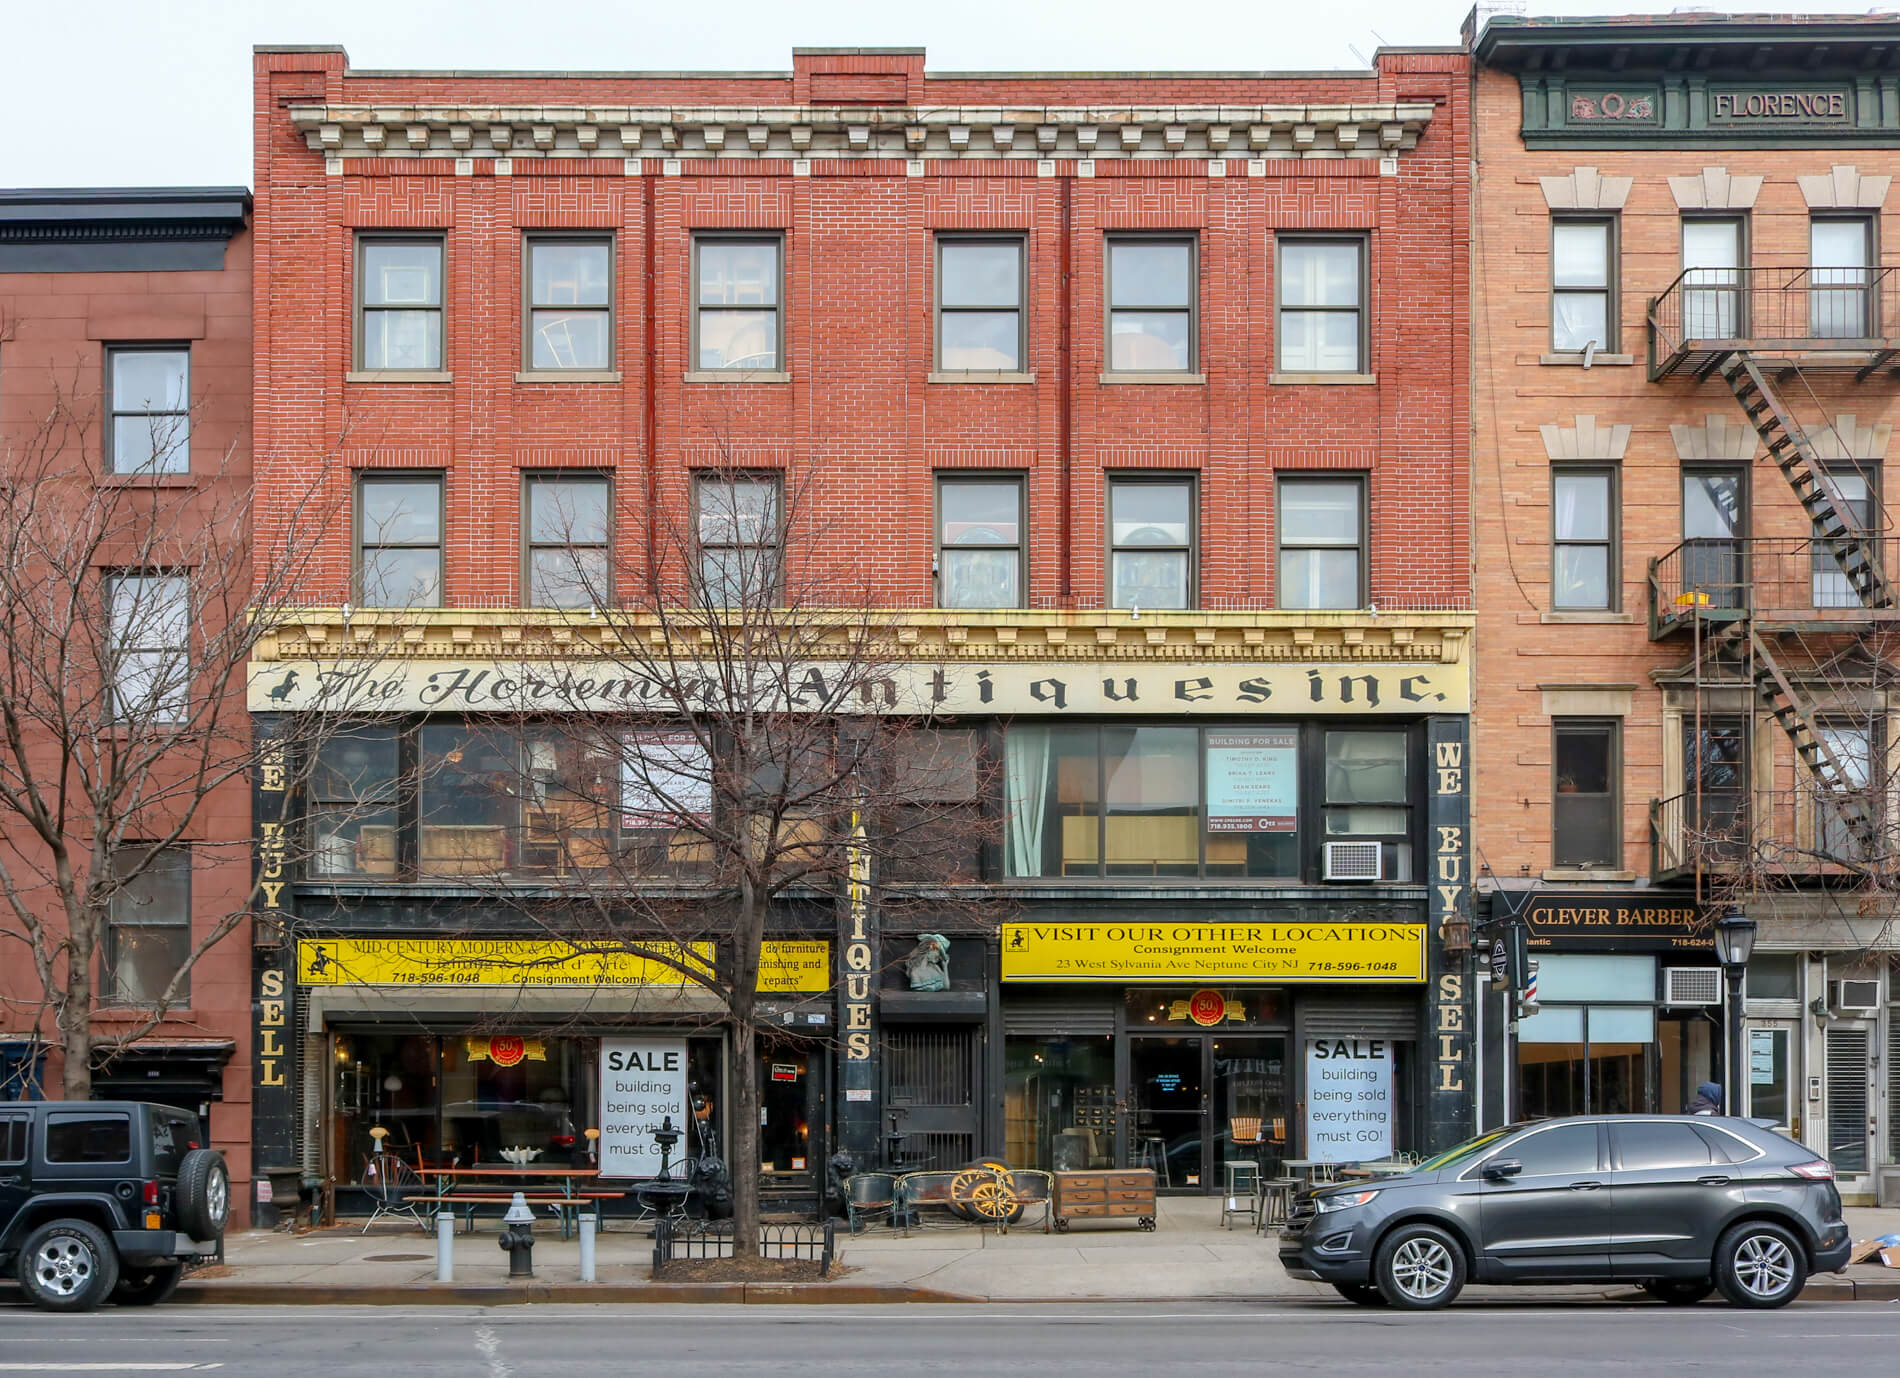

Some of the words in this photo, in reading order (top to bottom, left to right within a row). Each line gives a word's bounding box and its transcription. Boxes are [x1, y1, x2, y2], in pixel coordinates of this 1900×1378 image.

[1714, 93, 1844, 117] FLORENCE
[316, 667, 403, 699] The
[790, 666, 1272, 710] Antiques
[1308, 669, 1447, 709] inc.
[1436, 742, 1462, 794] WE
[1437, 826, 1463, 912] BUY
[1532, 908, 1611, 926] CLEVER
[1616, 908, 1695, 926] BARBER
[1032, 927, 1100, 941] VISIT
[1107, 927, 1166, 942] OUR
[1172, 927, 1264, 942] OTHER
[1271, 927, 1421, 942] LOCATIONS
[461, 940, 524, 954] MODERN
[765, 943, 778, 953] do
[782, 943, 826, 953] furniture
[1133, 944, 1227, 956] Consignment
[1233, 944, 1297, 955] Welcome
[802, 958, 821, 969] and
[1056, 959, 1071, 970] 23
[1075, 959, 1107, 970] West
[1110, 959, 1161, 972] Sylvania
[1165, 959, 1190, 970] Ave
[1195, 959, 1248, 972] Neptune
[1253, 959, 1278, 972] City
[1283, 959, 1299, 970] NJ
[1308, 961, 1399, 971] 718-596-1048
[392, 972, 480, 983] 718-596-1048
[512, 974, 590, 986] Consignment
[594, 974, 647, 984] Welcome
[261, 969, 285, 1086] SELL
[1439, 973, 1464, 1092] SELL
[1314, 1039, 1385, 1059] SALE
[608, 1051, 679, 1072] SALE
[1321, 1068, 1377, 1082] building
[615, 1080, 672, 1095] building
[1313, 1089, 1352, 1102] being
[1357, 1089, 1386, 1101] sold
[606, 1101, 647, 1115] being
[650, 1101, 680, 1114] sold
[1312, 1110, 1387, 1124] everything
[1316, 1132, 1351, 1142] must
[1356, 1130, 1384, 1142] GO!
[609, 1144, 644, 1155] must
